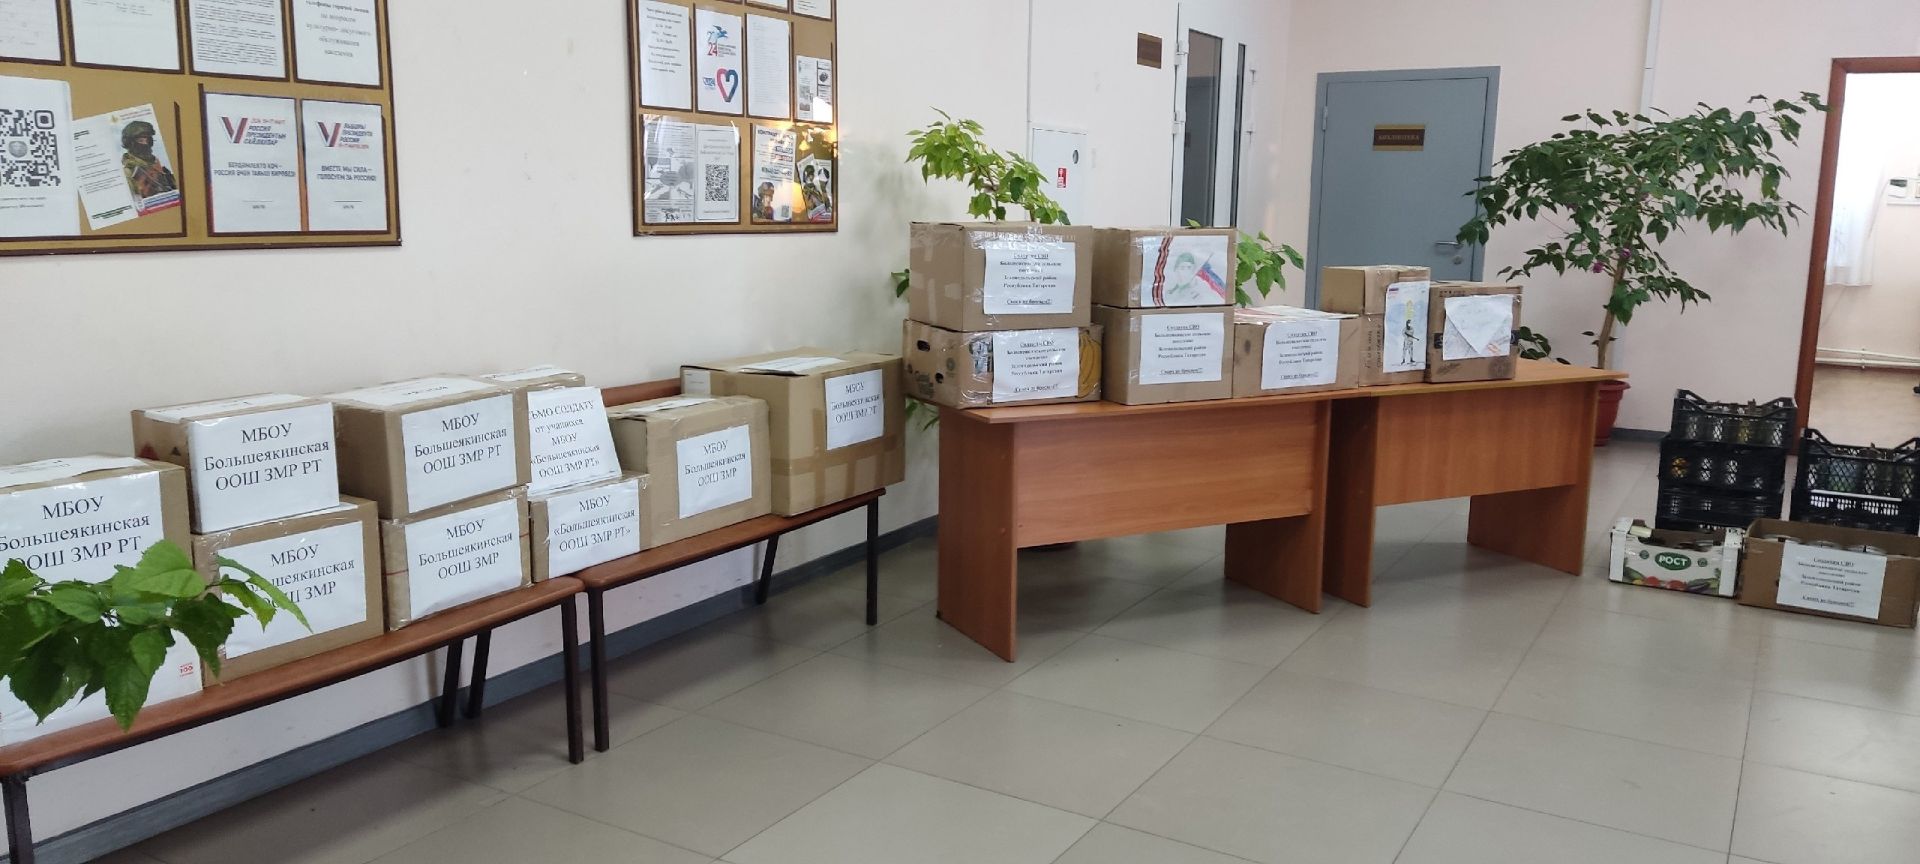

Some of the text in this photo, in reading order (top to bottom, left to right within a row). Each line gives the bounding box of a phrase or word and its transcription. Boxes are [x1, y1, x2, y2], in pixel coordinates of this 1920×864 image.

[846, 381, 865, 394] МБОУ
[529, 400, 594, 420] ЬМО СОЛДАТУ
[241, 422, 292, 444] МБОУ
[441, 412, 480, 433] МБОУ
[535, 425, 544, 433] от
[413, 427, 507, 458] Большеякинская
[551, 432, 577, 446] МБОУ
[703, 439, 728, 456] МБОУ
[204, 439, 330, 472] Большеякинская
[423, 445, 502, 475] ООШ ЗМР РТ
[684, 452, 746, 475] Большеякинская
[215, 458, 323, 491] ООШ ЗМР РТ
[539, 463, 564, 478] ООШ
[565, 460, 583, 473] ЗМР
[697, 466, 737, 487] ООШ ЗМР
[42, 495, 104, 520] МБОУ
[579, 494, 611, 512] МБОУ
[447, 518, 485, 541] МБОУ
[553, 509, 635, 536] «Большеякинская
[418, 532, 513, 567] Большеякинская
[559, 526, 631, 553] ООШ ЗМР РТ»
[16, 535, 142, 571] ОШ ЗМР РТ
[271, 543, 319, 567] МБОУ
[1658, 555, 1688, 567] РОСТ
[437, 551, 499, 581] ООШ ЗМР
[304, 580, 336, 600] ЗМР
